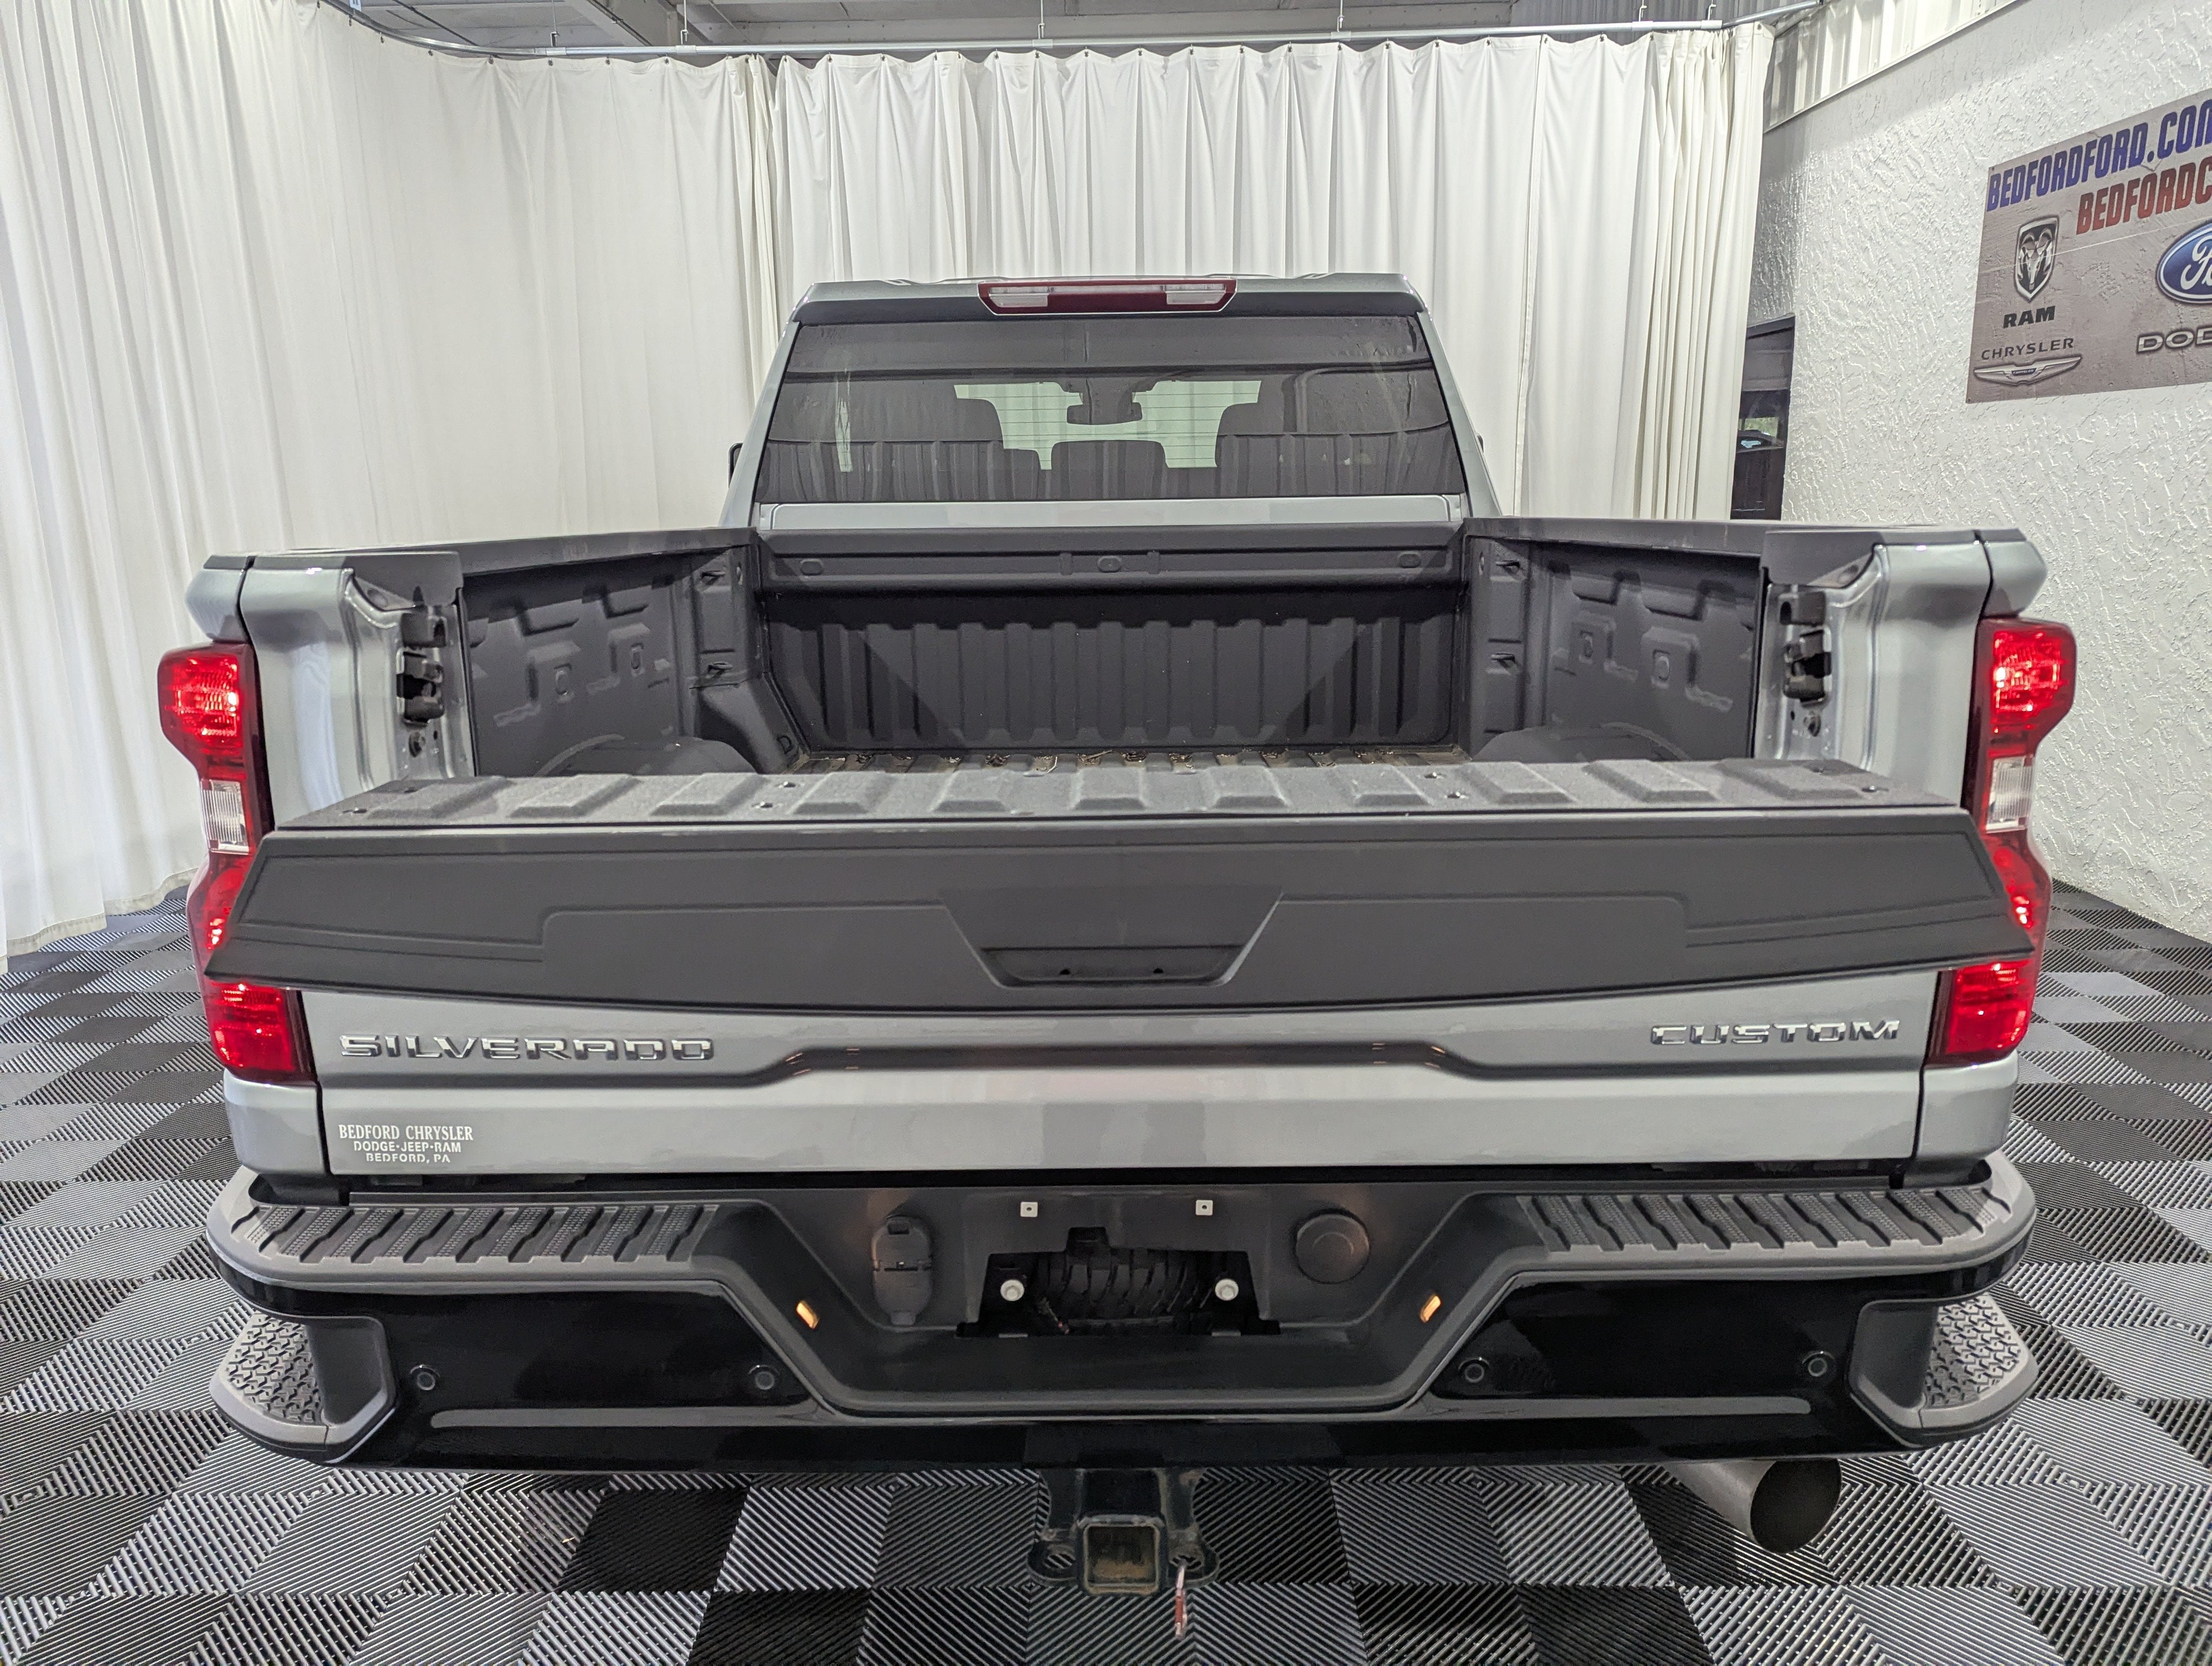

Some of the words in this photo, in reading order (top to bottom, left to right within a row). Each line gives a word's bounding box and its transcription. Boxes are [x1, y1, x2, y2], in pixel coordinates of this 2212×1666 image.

[2003, 305, 2055, 329] RAM
[1981, 338, 2074, 360] CHRYSLER
[1651, 1020, 1900, 1044] CUSTOM
[339, 1035, 714, 1060] SILVERADO
[338, 1124, 400, 1140] BEDFORD
[405, 1125, 473, 1141] CHRYSLER
[366, 1153, 429, 1164] BEDFORD,
[434, 1154, 451, 1163] PA
